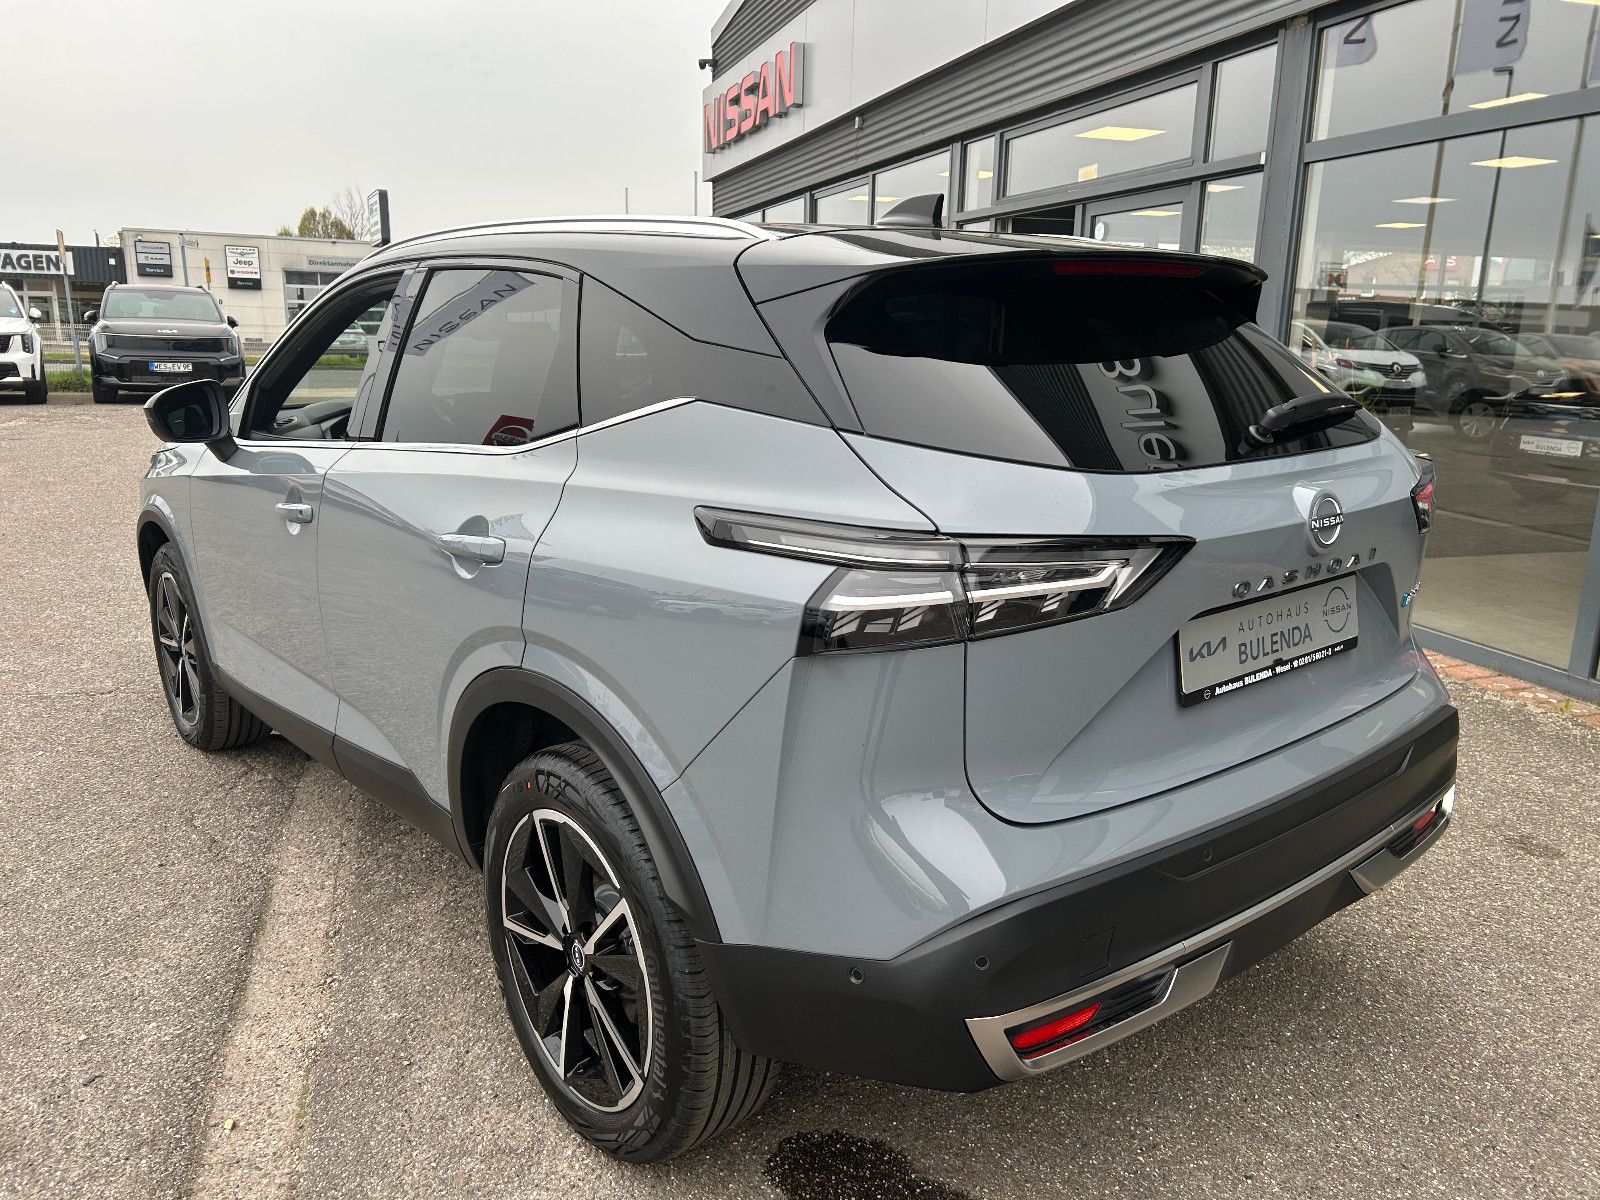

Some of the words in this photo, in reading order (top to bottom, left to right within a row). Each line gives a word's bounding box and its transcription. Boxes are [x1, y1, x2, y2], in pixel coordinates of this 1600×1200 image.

[703, 41, 803, 154] NISSAN
[0, 252, 61, 272] AGEN
[232, 258, 254, 267] Jeep
[308, 259, 358, 267] Direktannahm
[413, 283, 518, 352] NISSAN
[1311, 513, 1345, 530] NISSAN
[1232, 547, 1377, 599] QASHQAI
[1237, 601, 1310, 634] AUTOHAUS
[1322, 601, 1352, 618] NISSAN
[1237, 623, 1313, 665] BULENDA
[1214, 680, 1244, 696] Autohaus
[1244, 669, 1273, 685] BULENDA
[1275, 661, 1291, 675] Wesel
